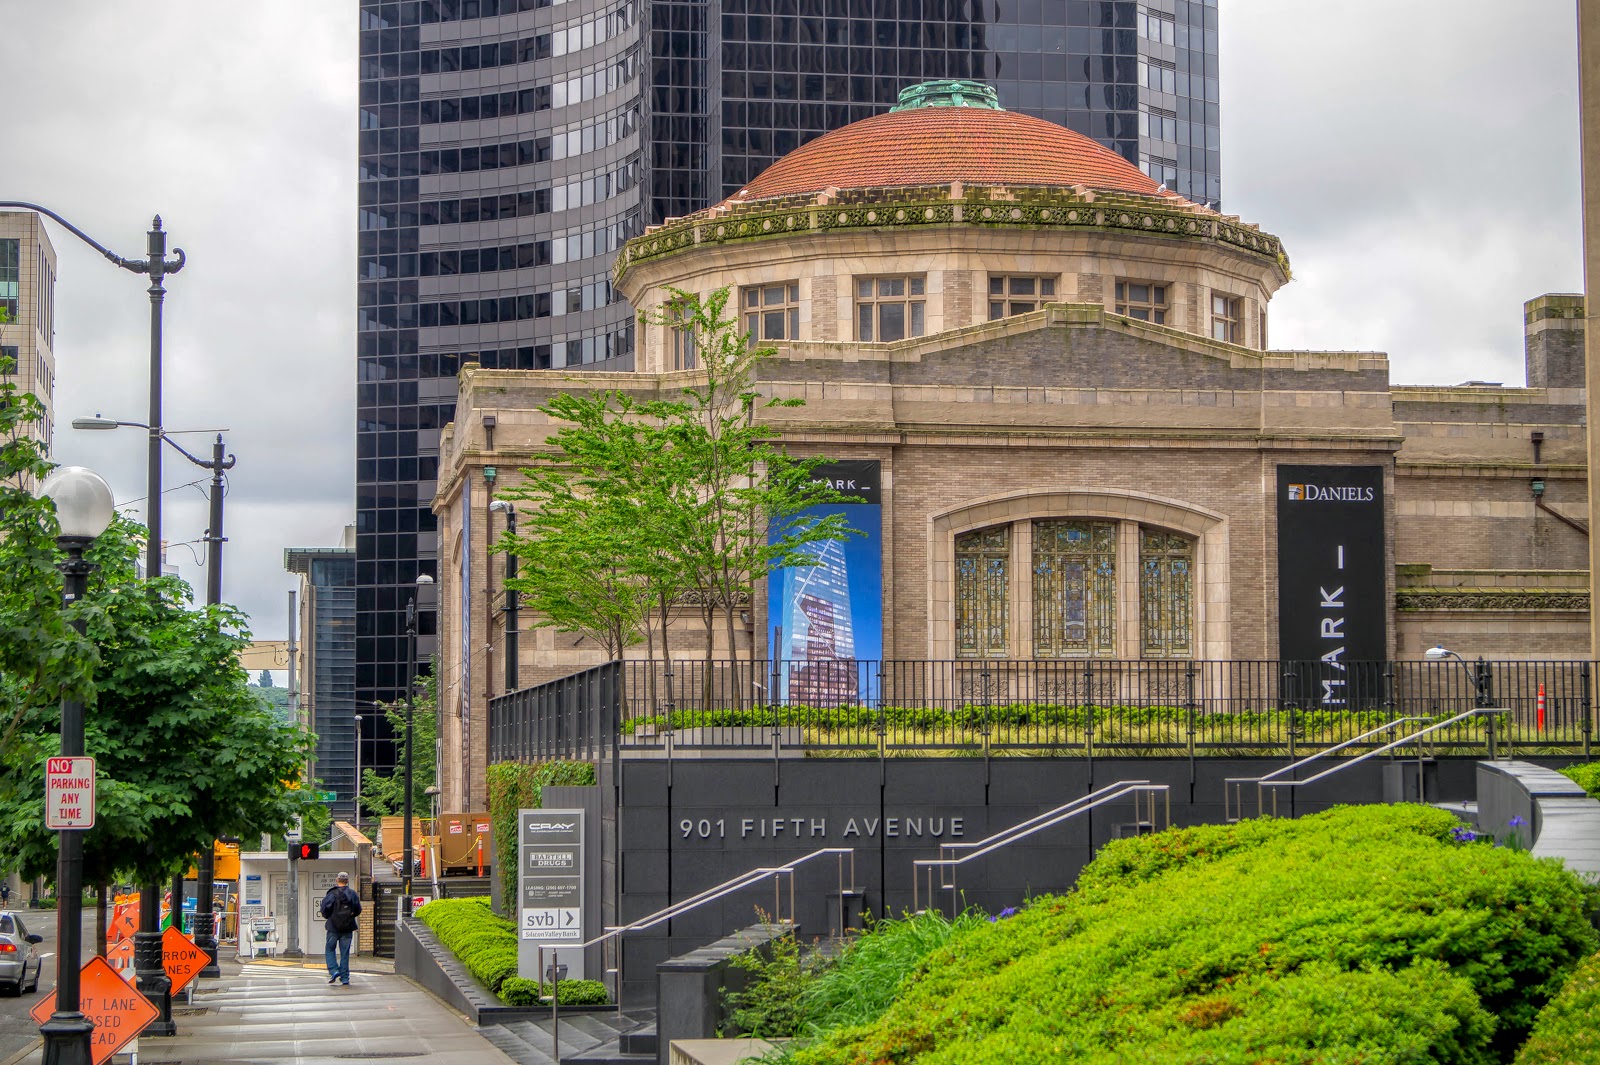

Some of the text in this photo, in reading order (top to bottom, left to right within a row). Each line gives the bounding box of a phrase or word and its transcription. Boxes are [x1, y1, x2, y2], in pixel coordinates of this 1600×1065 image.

[1304, 484, 1374, 501] DANIELS
[1320, 584, 1346, 704] MARK
[50, 759, 70, 773] NO
[51, 778, 90, 789] PARKING
[60, 793, 80, 804] ANY
[59, 808, 82, 819] TIME
[680, 817, 965, 838] 901 FIFTH AVENUE
[527, 911, 554, 926] svb
[163, 950, 197, 960] RROW
[163, 965, 190, 975] NES
[103, 998, 137, 1011] LANE
[87, 1015, 121, 1027] SED
[91, 1032, 116, 1045] EAD
